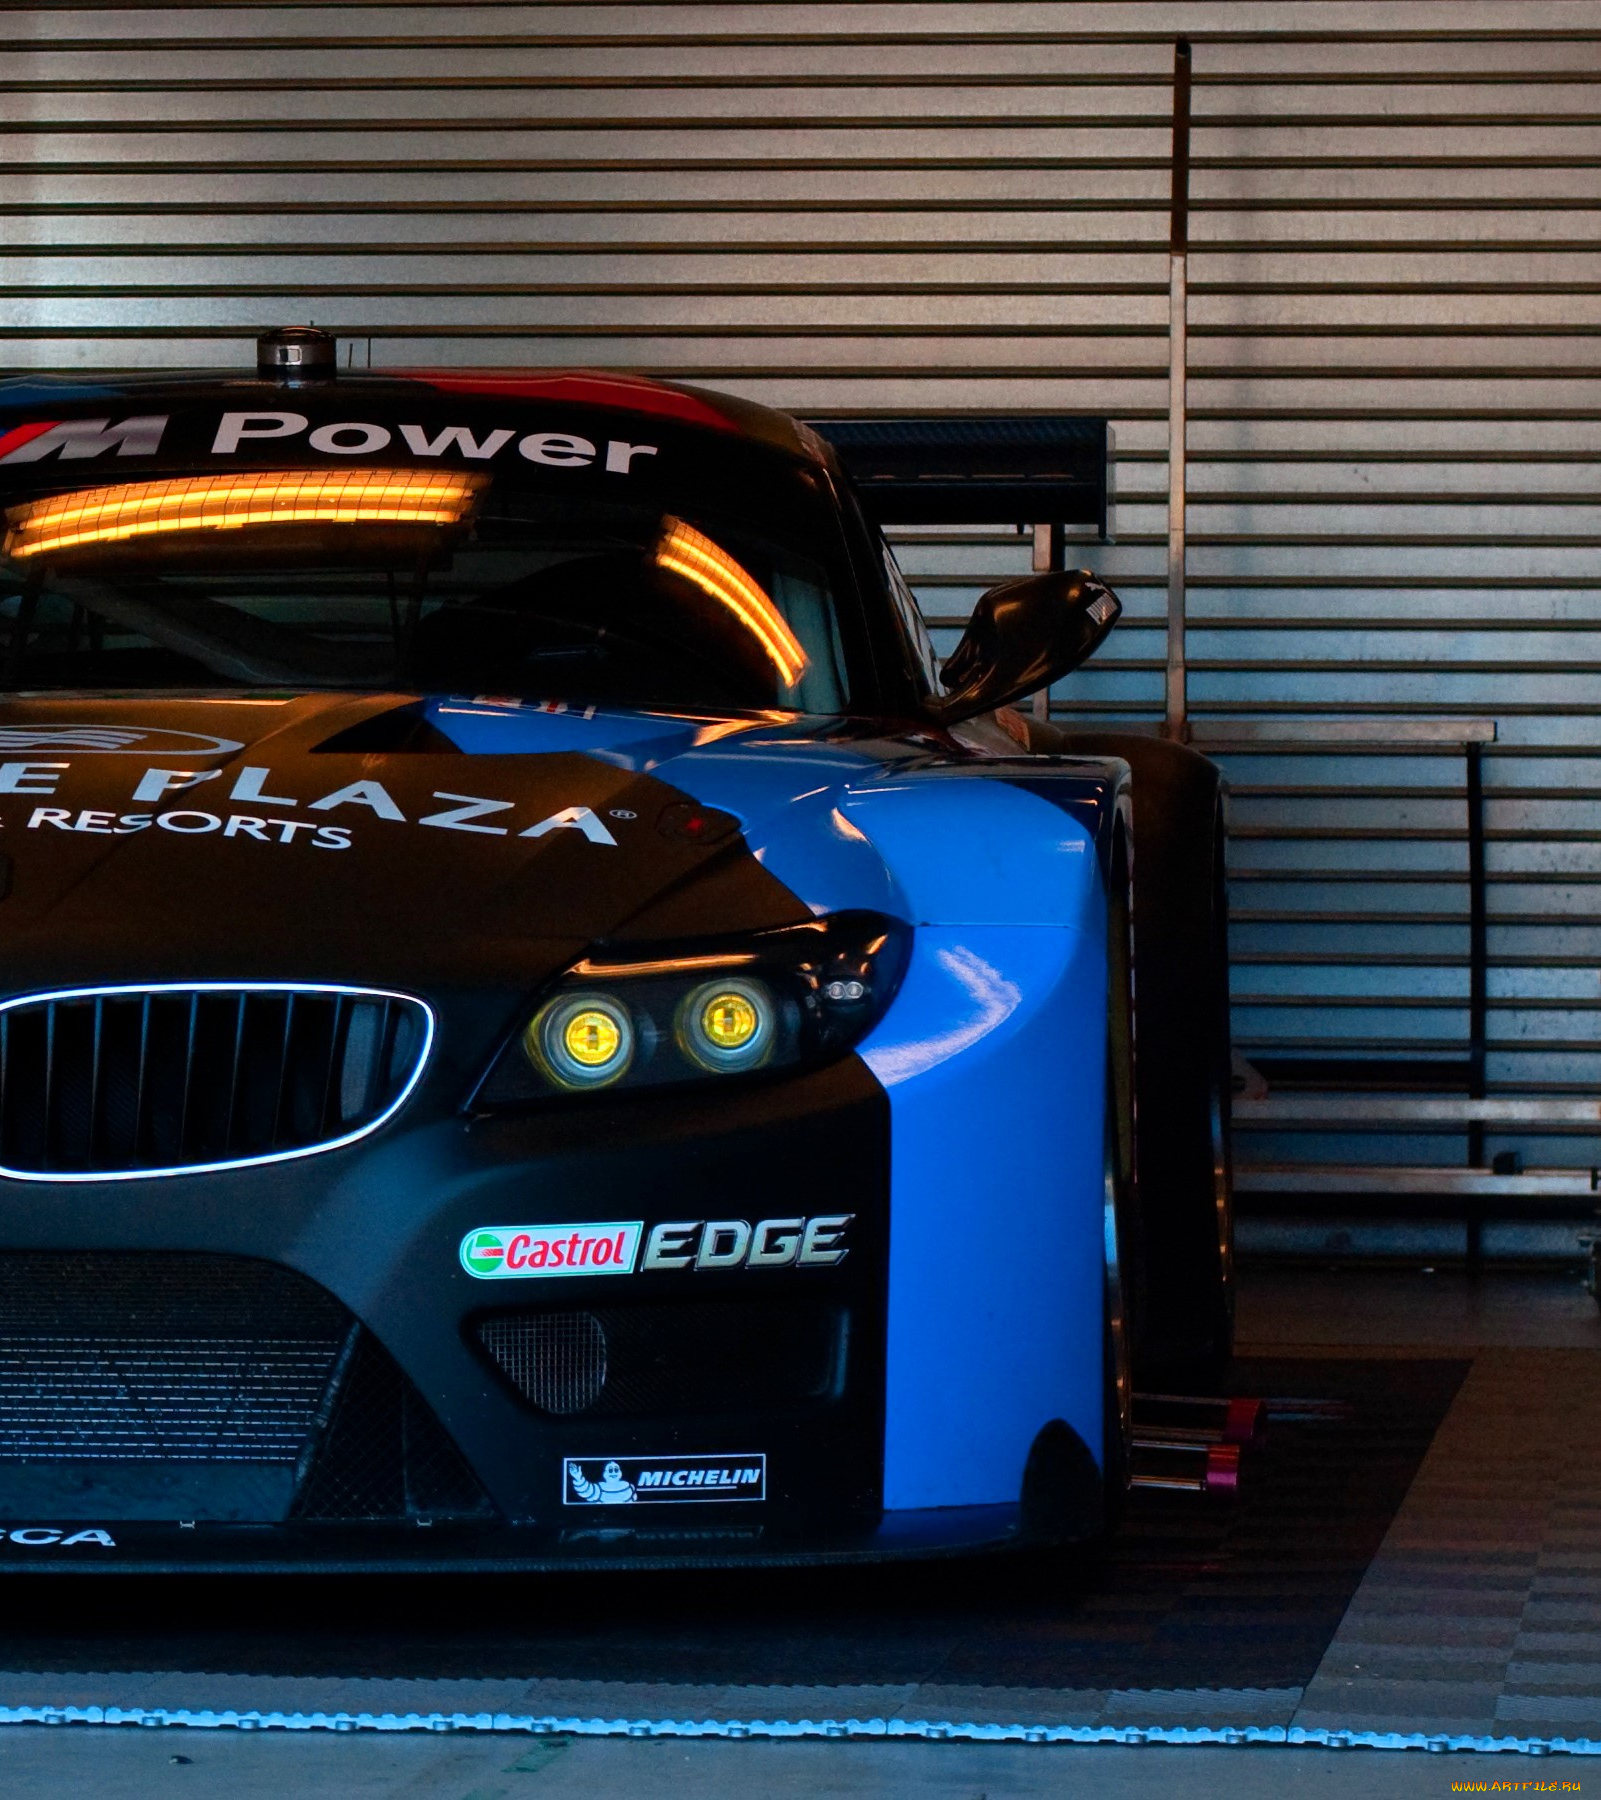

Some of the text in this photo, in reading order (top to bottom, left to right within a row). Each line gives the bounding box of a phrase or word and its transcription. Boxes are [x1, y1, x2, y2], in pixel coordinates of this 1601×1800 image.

[210, 411, 660, 475] Power
[26, 807, 354, 851] RESORTS
[506, 1213, 857, 1273] Castrol EDGE
[636, 1468, 762, 1487] MICHELIN
